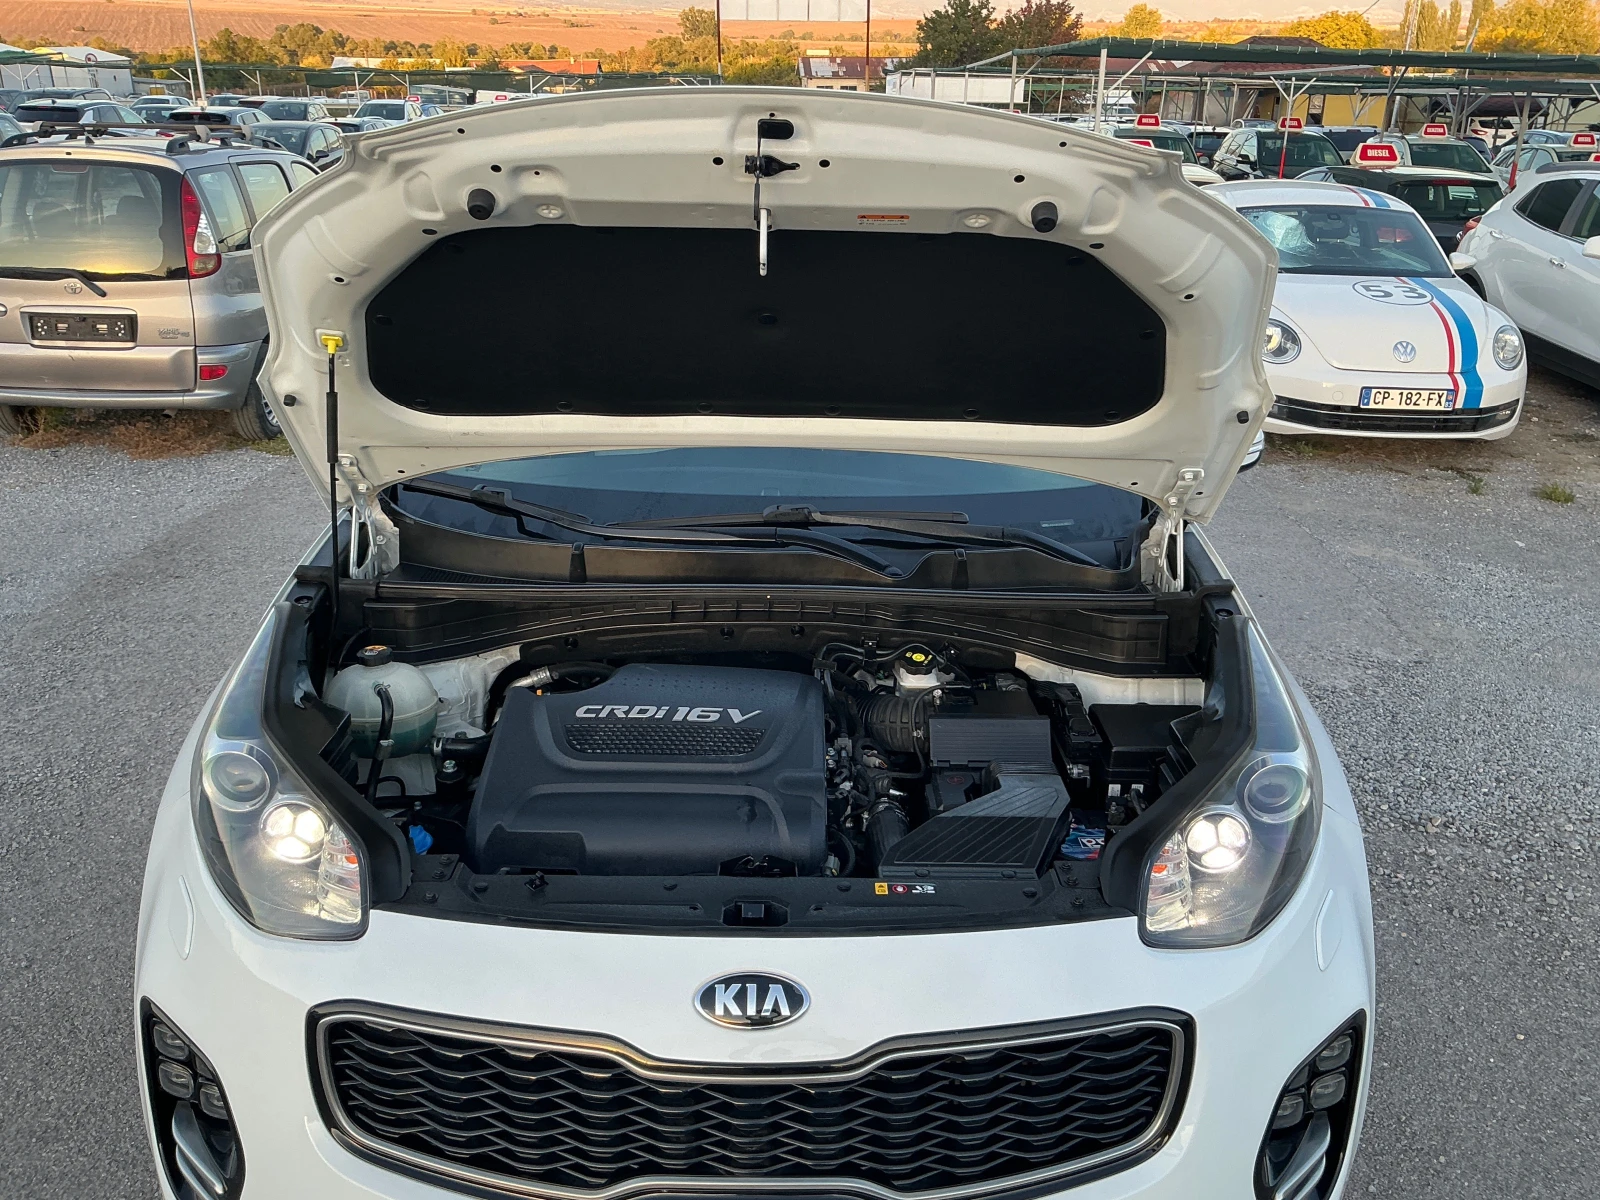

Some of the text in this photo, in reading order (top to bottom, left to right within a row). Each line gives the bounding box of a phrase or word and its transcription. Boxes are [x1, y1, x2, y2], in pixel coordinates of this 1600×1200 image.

[1367, 149, 1391, 157] DIESEL
[1360, 284, 1428, 299] 53
[1373, 390, 1445, 407] CP-182-FX
[575, 704, 764, 724] CRDi 16V
[714, 983, 791, 1016] KIA
